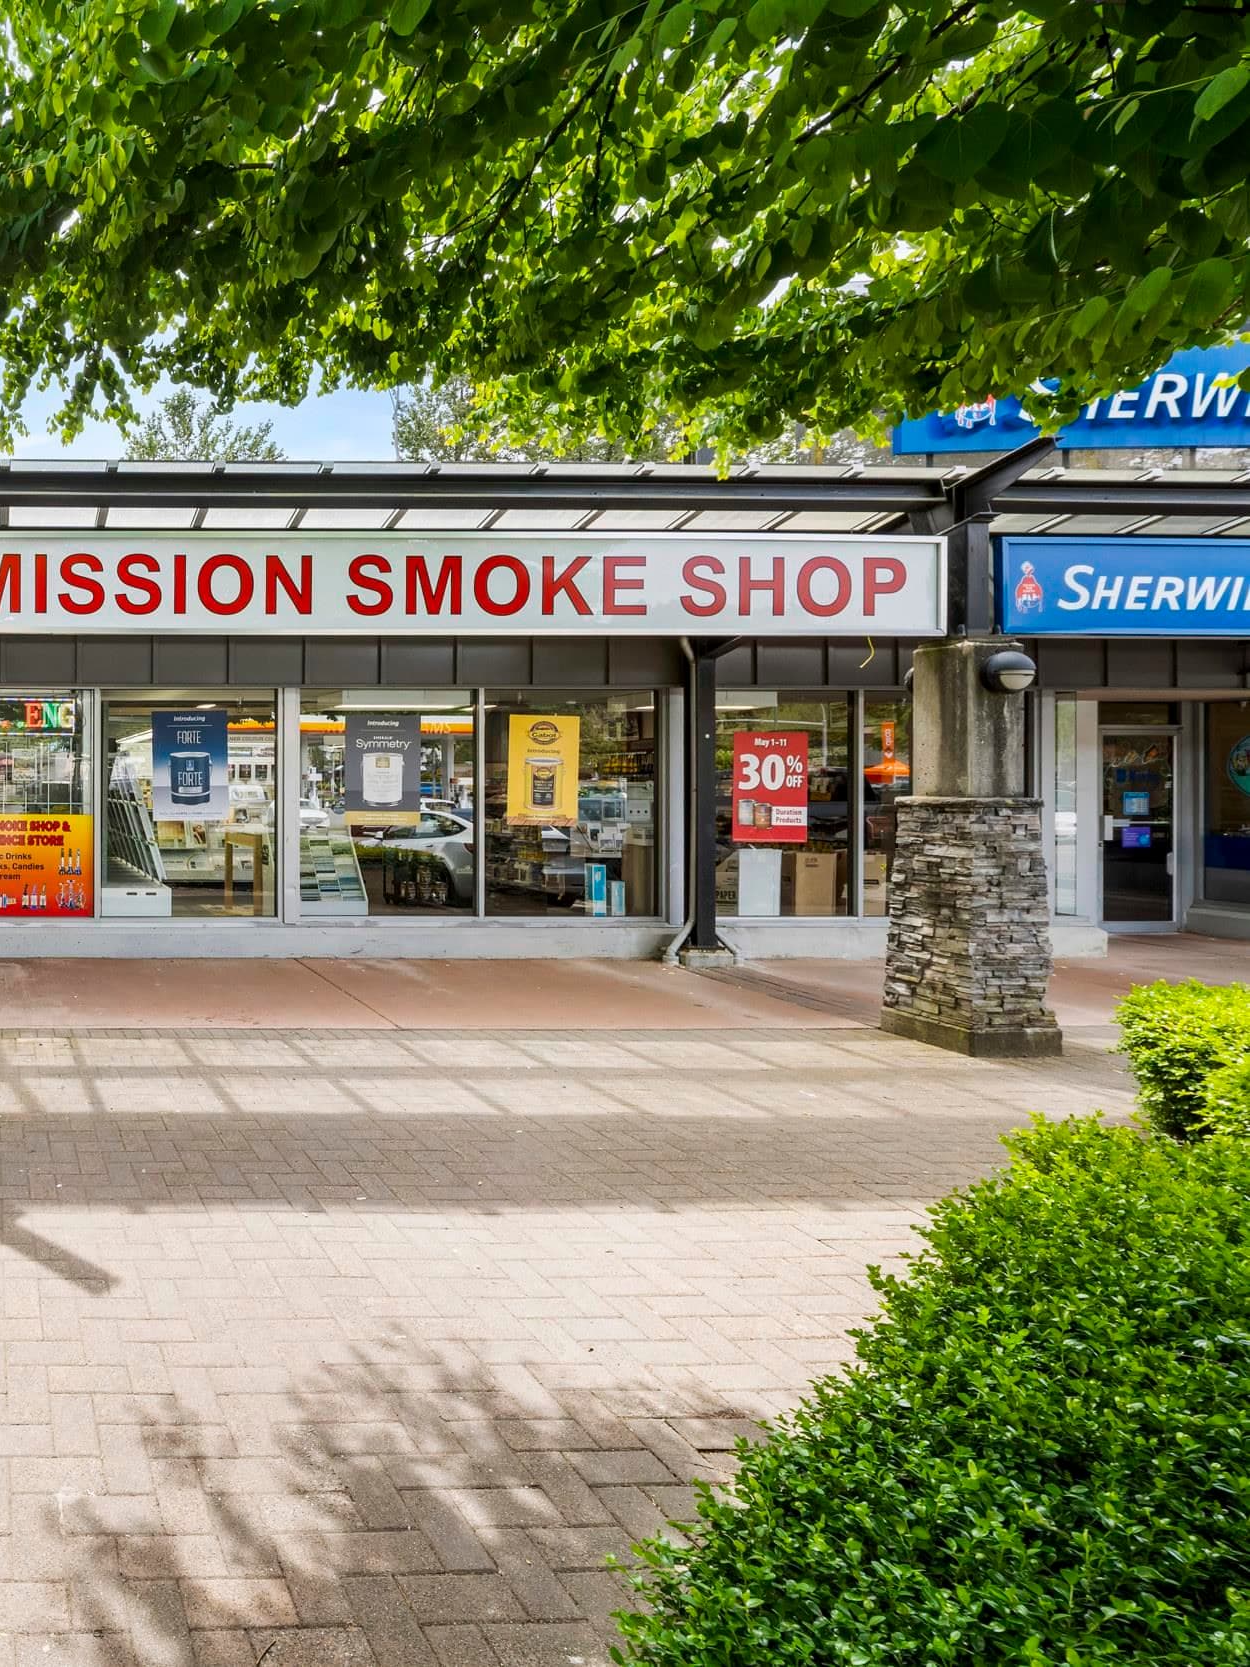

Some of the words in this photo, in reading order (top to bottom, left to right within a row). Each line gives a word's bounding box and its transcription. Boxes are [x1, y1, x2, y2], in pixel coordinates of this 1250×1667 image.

[1017, 373, 1250, 422] ERW
[346, 554, 648, 617] SMOKE
[680, 555, 907, 617] SHOP
[1057, 564, 1250, 611] SHERWI
[177, 730, 201, 744] FORTE
[754, 738, 770, 747] May
[356, 738, 411, 750] Symmetry
[178, 771, 203, 786] FORTE
[786, 776, 803, 788] OFF
[775, 808, 802, 816] Duration
[30, 821, 60, 832] SHOP
[62, 822, 71, 832] &
[28, 835, 64, 846] STORE
